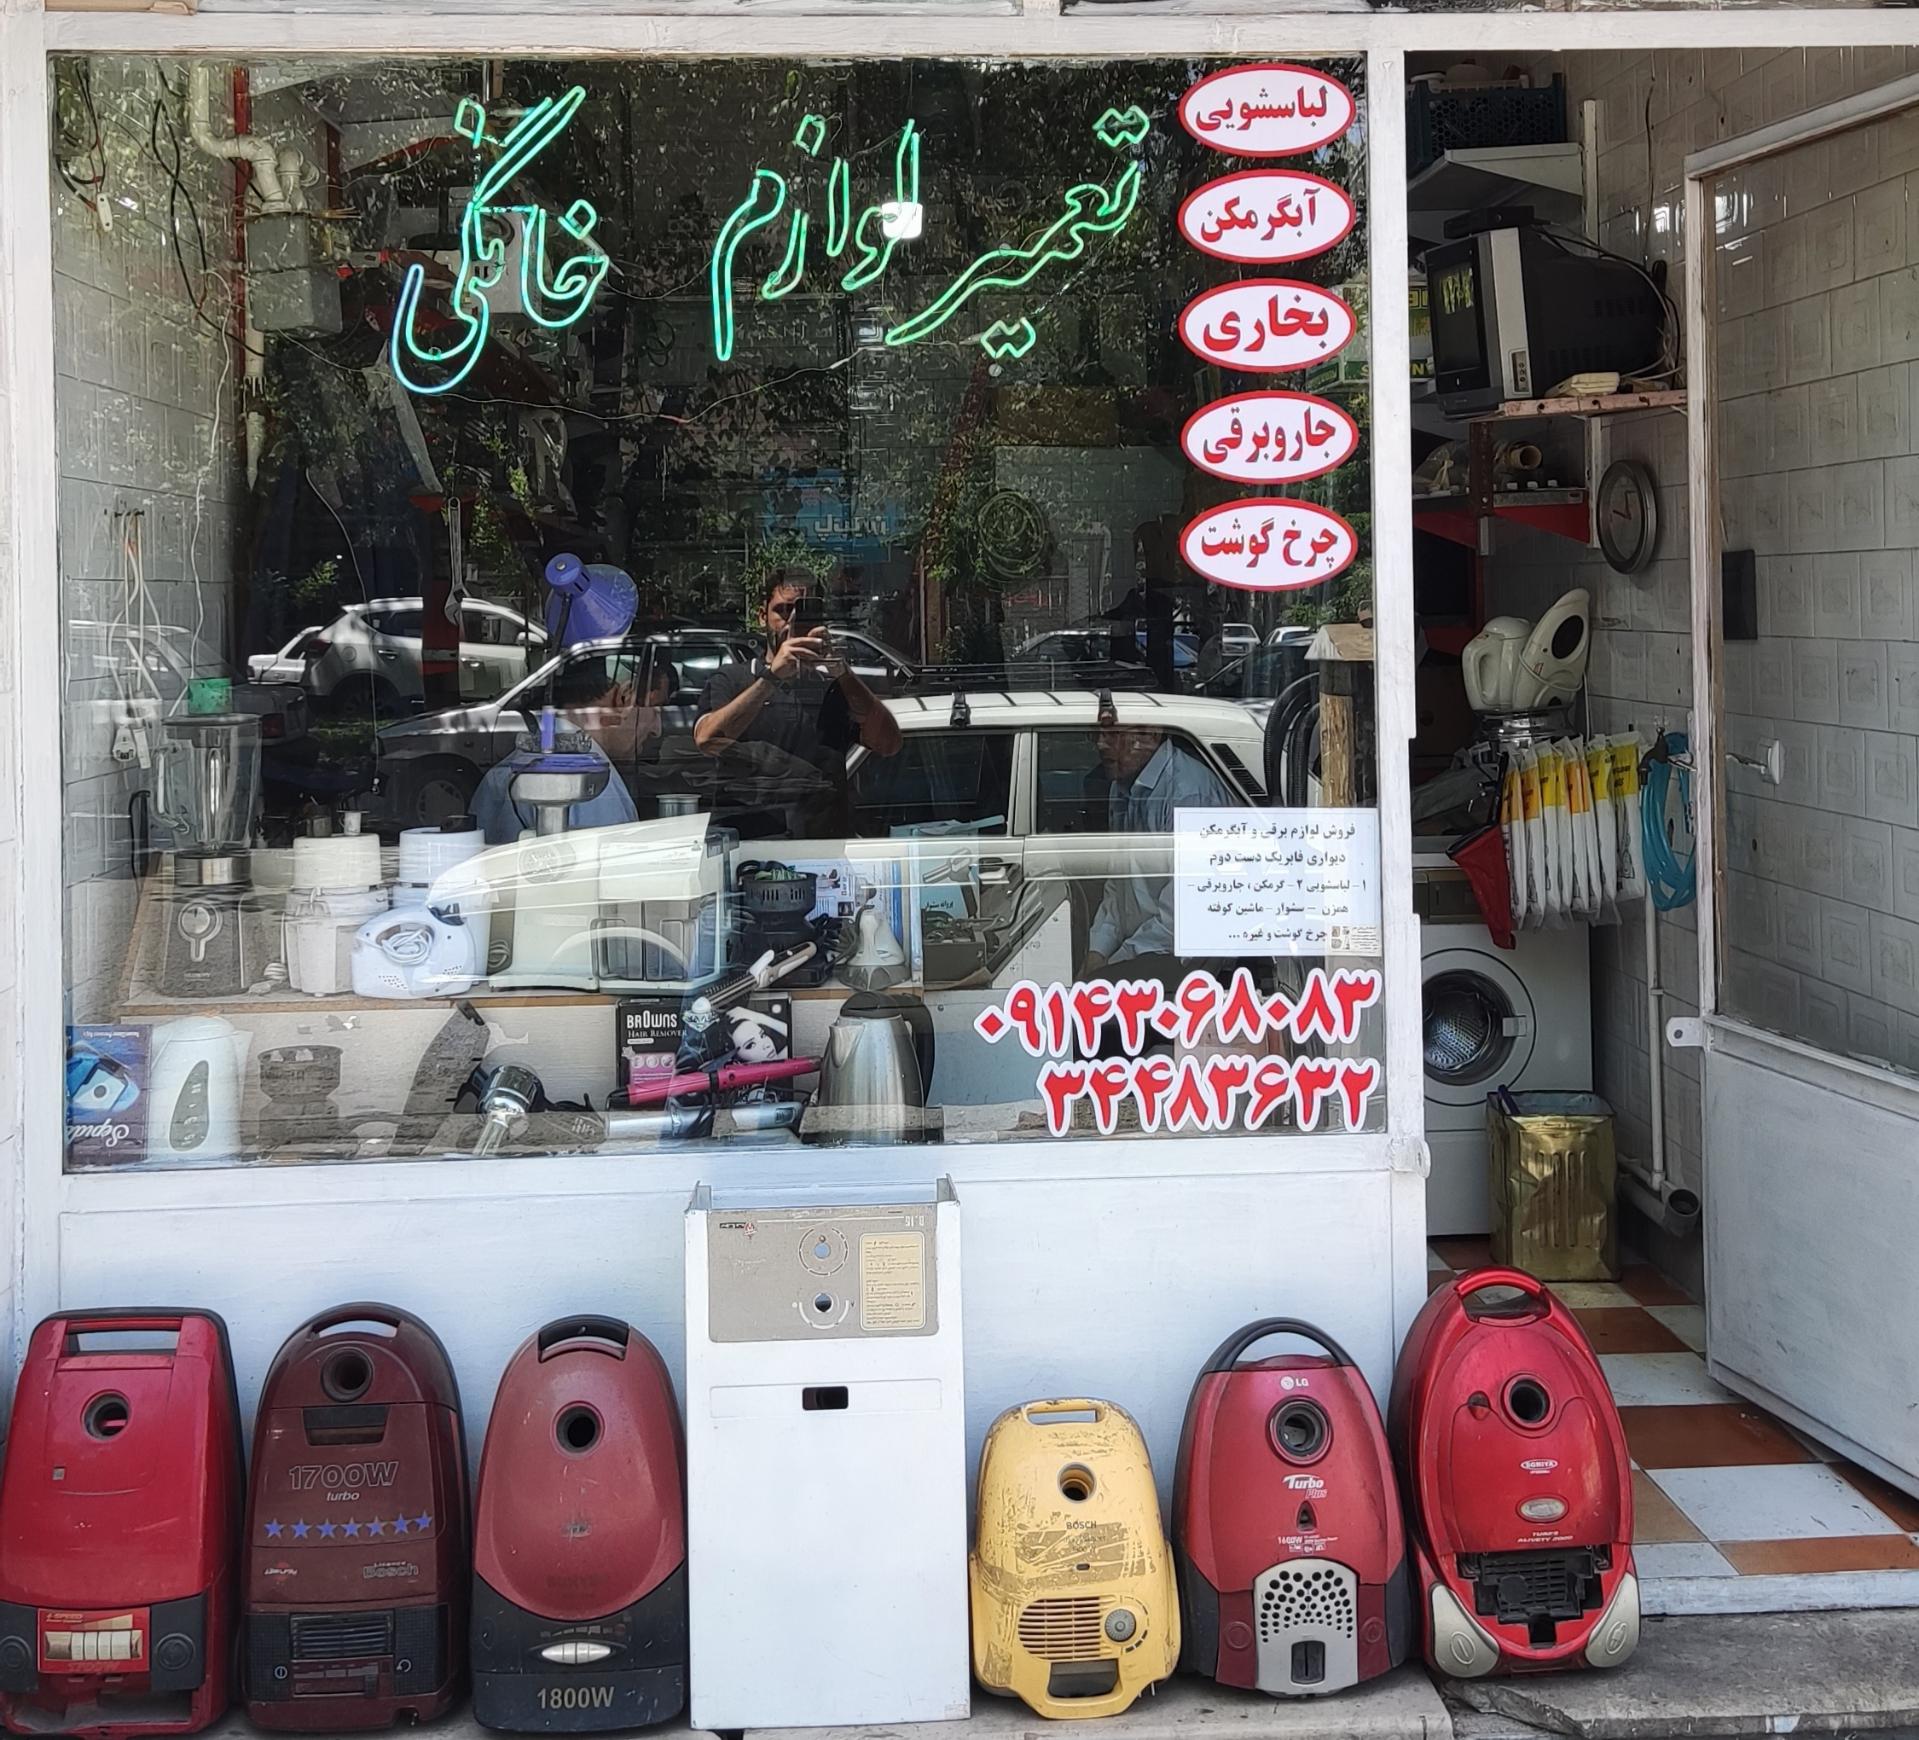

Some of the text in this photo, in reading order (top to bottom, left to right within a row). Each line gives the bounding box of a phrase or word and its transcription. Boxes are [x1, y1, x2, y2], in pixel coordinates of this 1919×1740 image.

[1194, 84, 1329, 131] لباسشویی
[1200, 187, 1321, 243] آبگرمکن
[391, 84, 1151, 394] تعمیر لوازم خانگی
[1202, 294, 1330, 352] بخاری
[1202, 405, 1337, 464] جاروبرقی
[1200, 516, 1339, 568] چرخ گوشت
[1260, 823, 1288, 840] برقی
[1290, 824, 1320, 840] لوازم
[1322, 824, 1356, 840] فروش
[1209, 850, 1346, 866] دیواری فابریک دست دوم
[1306, 879, 1351, 892] لباسشویی
[1235, 902, 1264, 916] ماشین
[1274, 927, 1303, 942] گوشت
[1305, 928, 1328, 942] چرخ
[978, 970, 1378, 1054] ۰۹۱۴۳۰۶۸۰۸۳
[1042, 1060, 1376, 1133] ۳۴۴۸۳۶۳۲
[1295, 1377, 1309, 1387] LG
[289, 1461, 400, 1490] 1700W
[1283, 1474, 1325, 1489] Turbo
[326, 1491, 360, 1502] turbo
[1304, 1488, 1328, 1499] Plus
[1065, 1521, 1098, 1530] BOSCH
[362, 1563, 419, 1579] Bosch
[536, 1686, 615, 1710] 1800W
